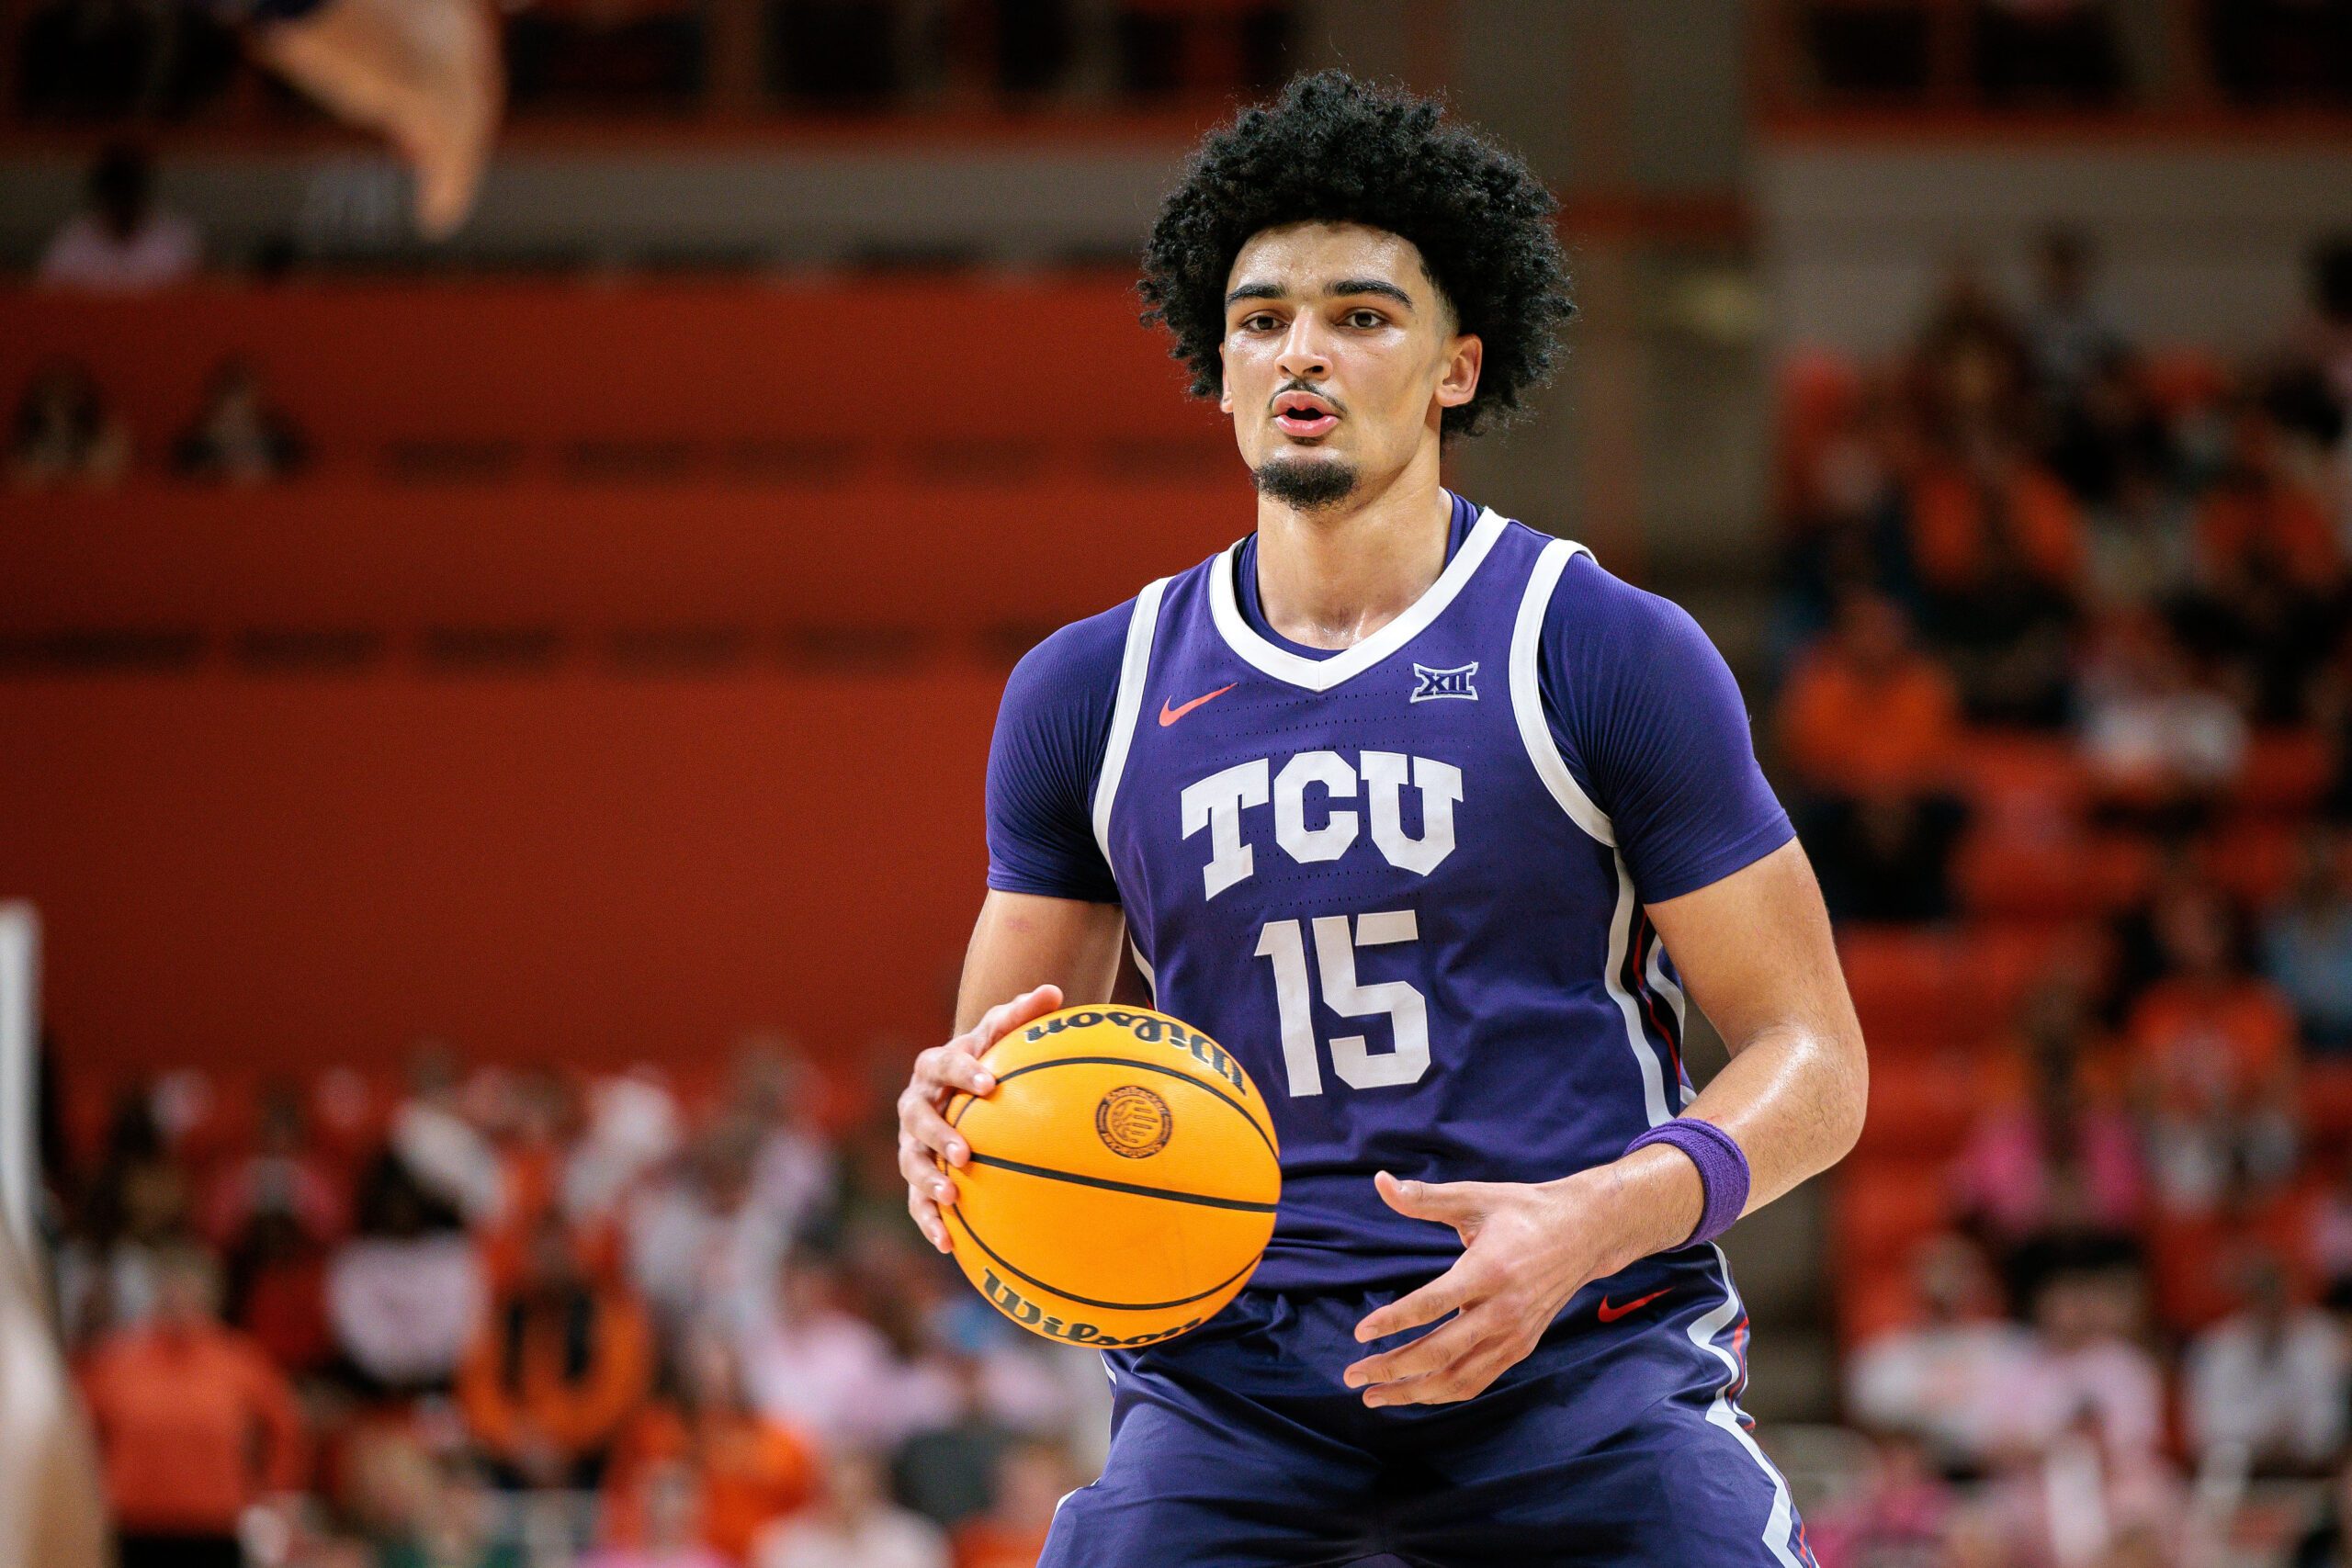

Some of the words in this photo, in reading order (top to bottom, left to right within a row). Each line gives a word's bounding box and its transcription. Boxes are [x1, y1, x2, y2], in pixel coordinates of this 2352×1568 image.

[1414, 665, 1475, 700] XII
[1181, 750, 1464, 901] TCU
[1253, 909, 1431, 1098] 15
[1024, 1011, 1247, 1097] Wilson
[983, 1267, 1203, 1346] Wilson
